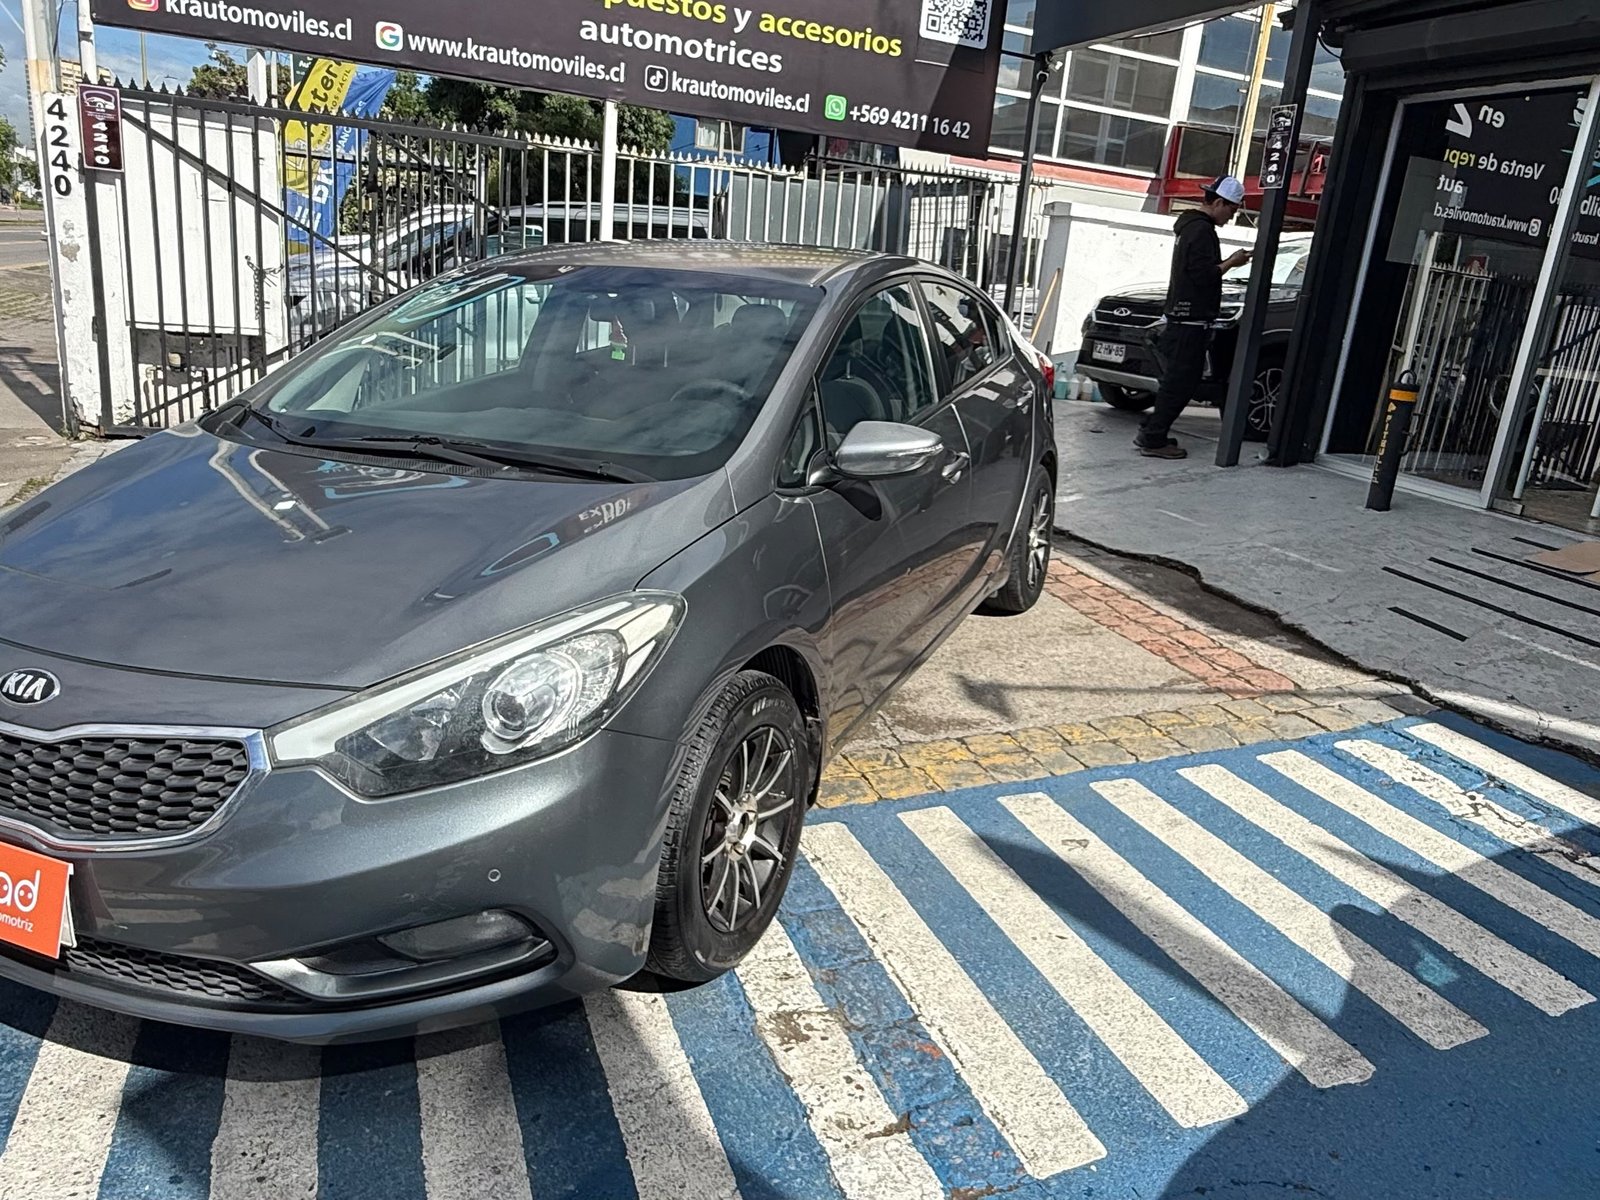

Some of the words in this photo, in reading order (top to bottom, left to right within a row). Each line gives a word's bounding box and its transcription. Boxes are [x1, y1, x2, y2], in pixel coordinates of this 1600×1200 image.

[166, 0, 352, 41] krautomoviles.cl
[733, 7, 752, 33] y
[758, 12, 903, 57] accesorios
[407, 33, 626, 83] www.krautomoviles.cl
[579, 20, 783, 73] automotrices
[672, 70, 810, 113] krautomoviles.cl
[91, 121, 111, 166] 4240
[849, 104, 890, 126] +569
[891, 110, 928, 132] 4211
[932, 116, 950, 136] 16
[951, 120, 971, 140] 42
[46, 98, 73, 197] 4240
[1266, 141, 1283, 183] 4240
[2, 671, 47, 701] KIA
